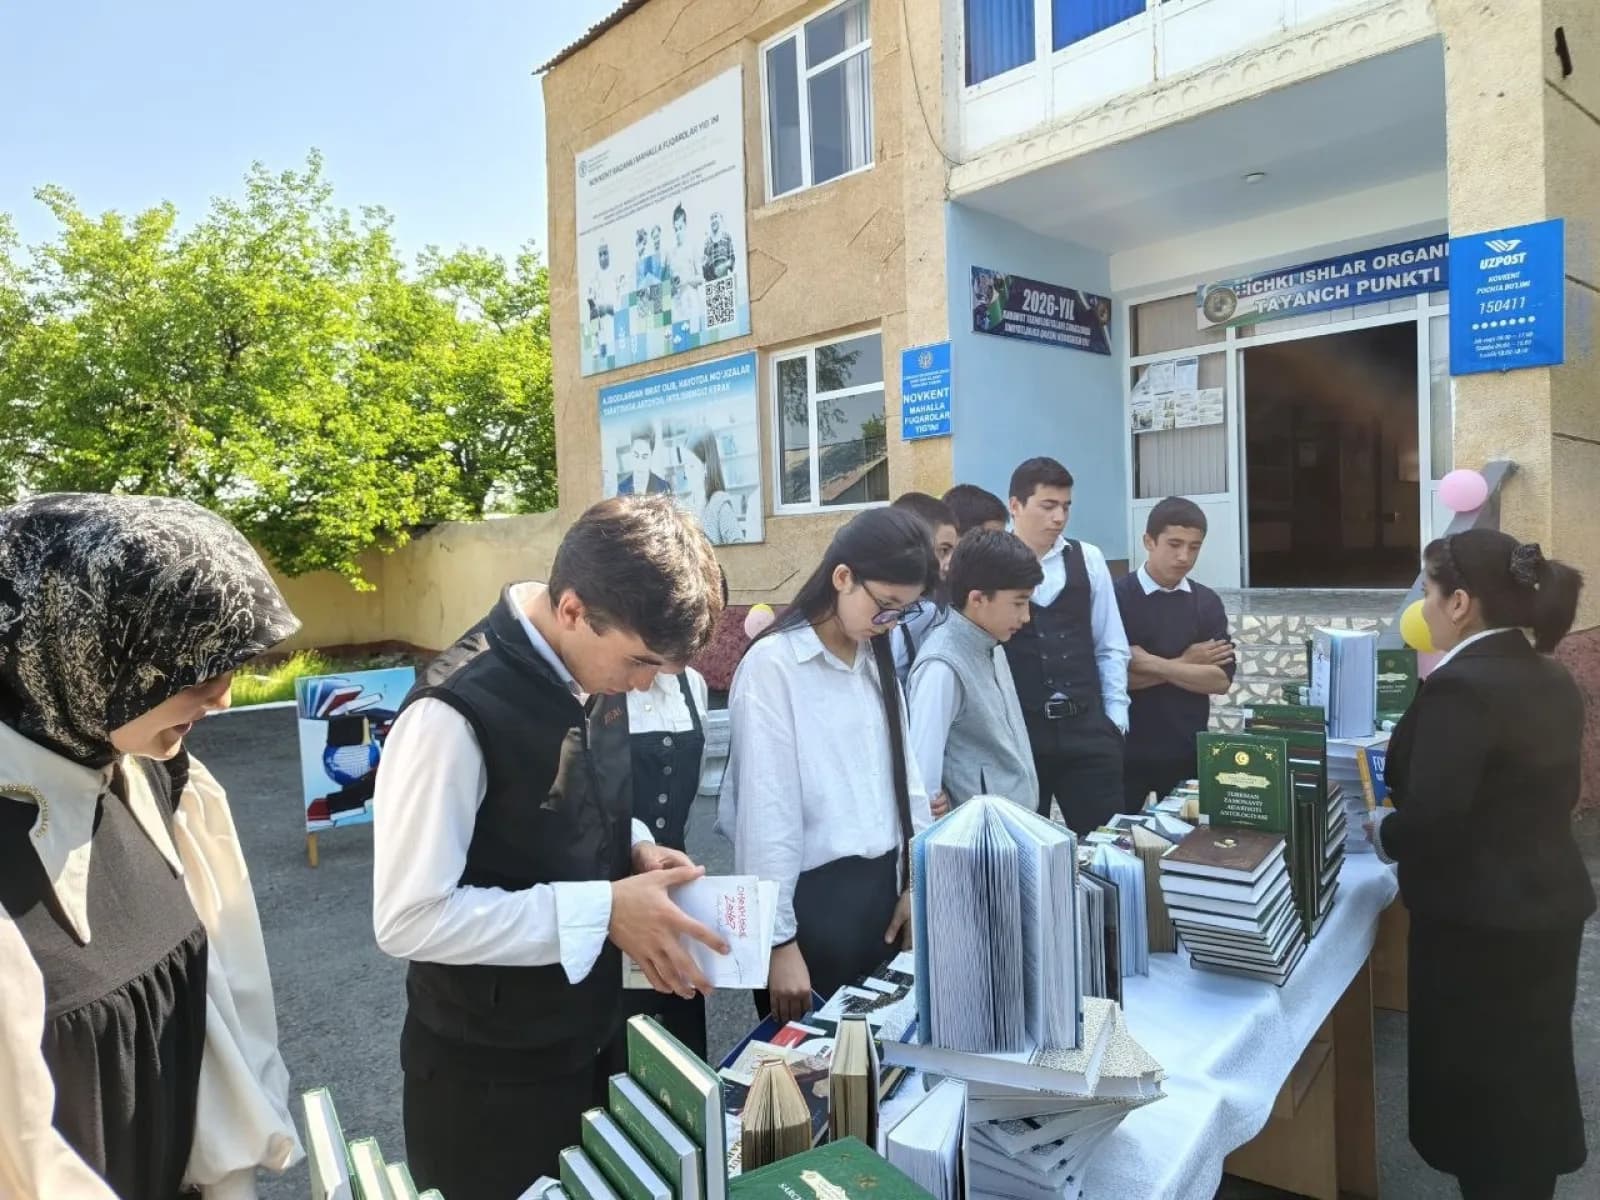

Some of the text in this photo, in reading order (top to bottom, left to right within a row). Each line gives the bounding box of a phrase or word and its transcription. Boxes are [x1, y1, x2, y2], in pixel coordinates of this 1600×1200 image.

[1479, 252, 1527, 270] UZPOST
[1246, 274, 1293, 296] ICHKI
[1300, 259, 1366, 285] ISHLAR
[1255, 266, 1440, 314] TAYANCH PUNKTI
[1022, 288, 1075, 321] 2026-YIL
[1479, 296, 1526, 315] 150411
[903, 387, 950, 404] NOVKENT
[909, 402, 945, 415] MAHALLA
